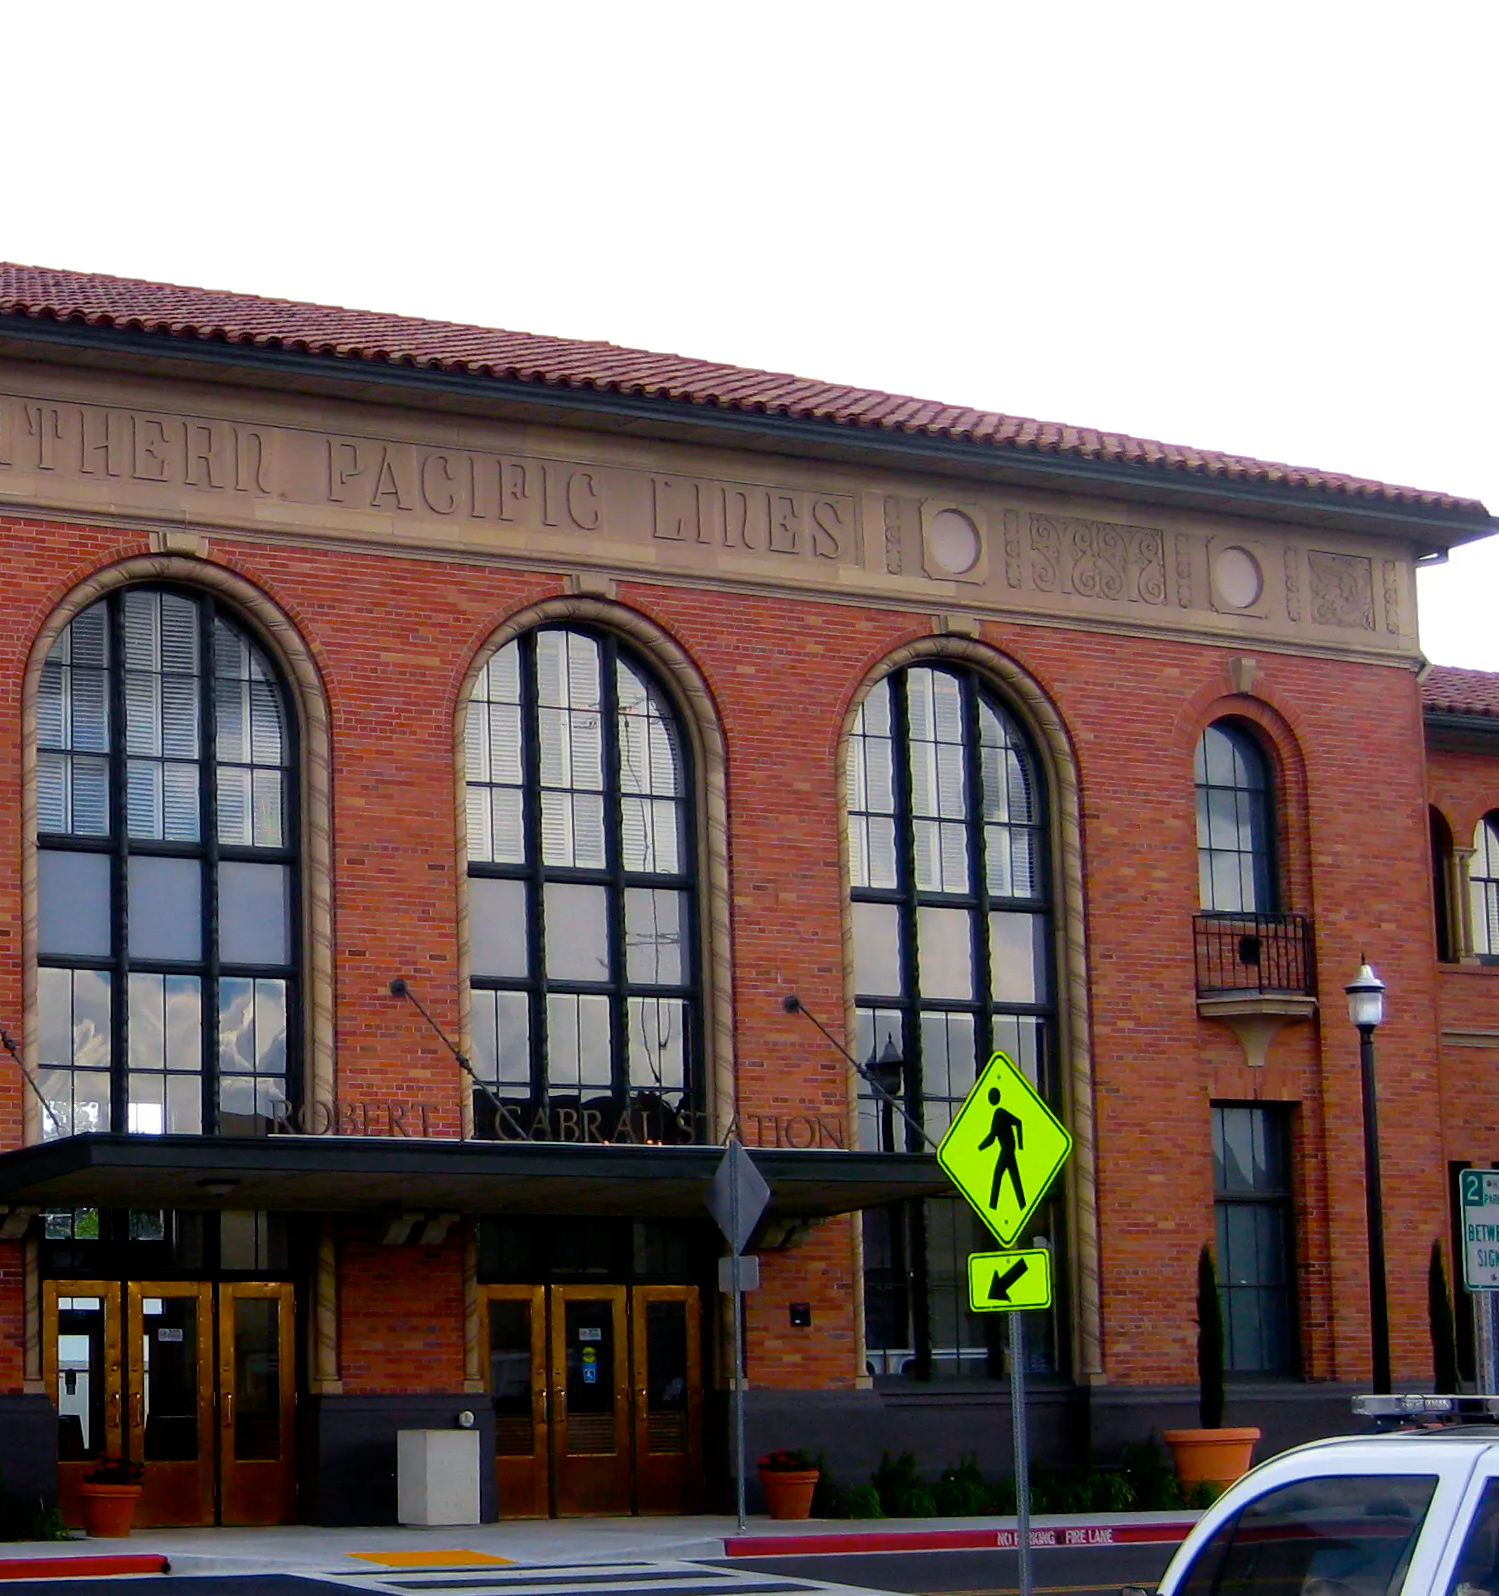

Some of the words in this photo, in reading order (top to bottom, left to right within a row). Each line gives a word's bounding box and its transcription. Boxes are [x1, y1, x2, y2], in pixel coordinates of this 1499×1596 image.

[324, 438, 601, 531] PACIFIC
[650, 475, 845, 560] LINES
[269, 1100, 440, 1138] ROBERT
[675, 1110, 846, 1150] STATION
[1466, 1175, 1479, 1200] 2
[1014, 1530, 1056, 1546] PRKING
[1065, 1529, 1086, 1544] FIRE
[1088, 1528, 1114, 1543] LANE
